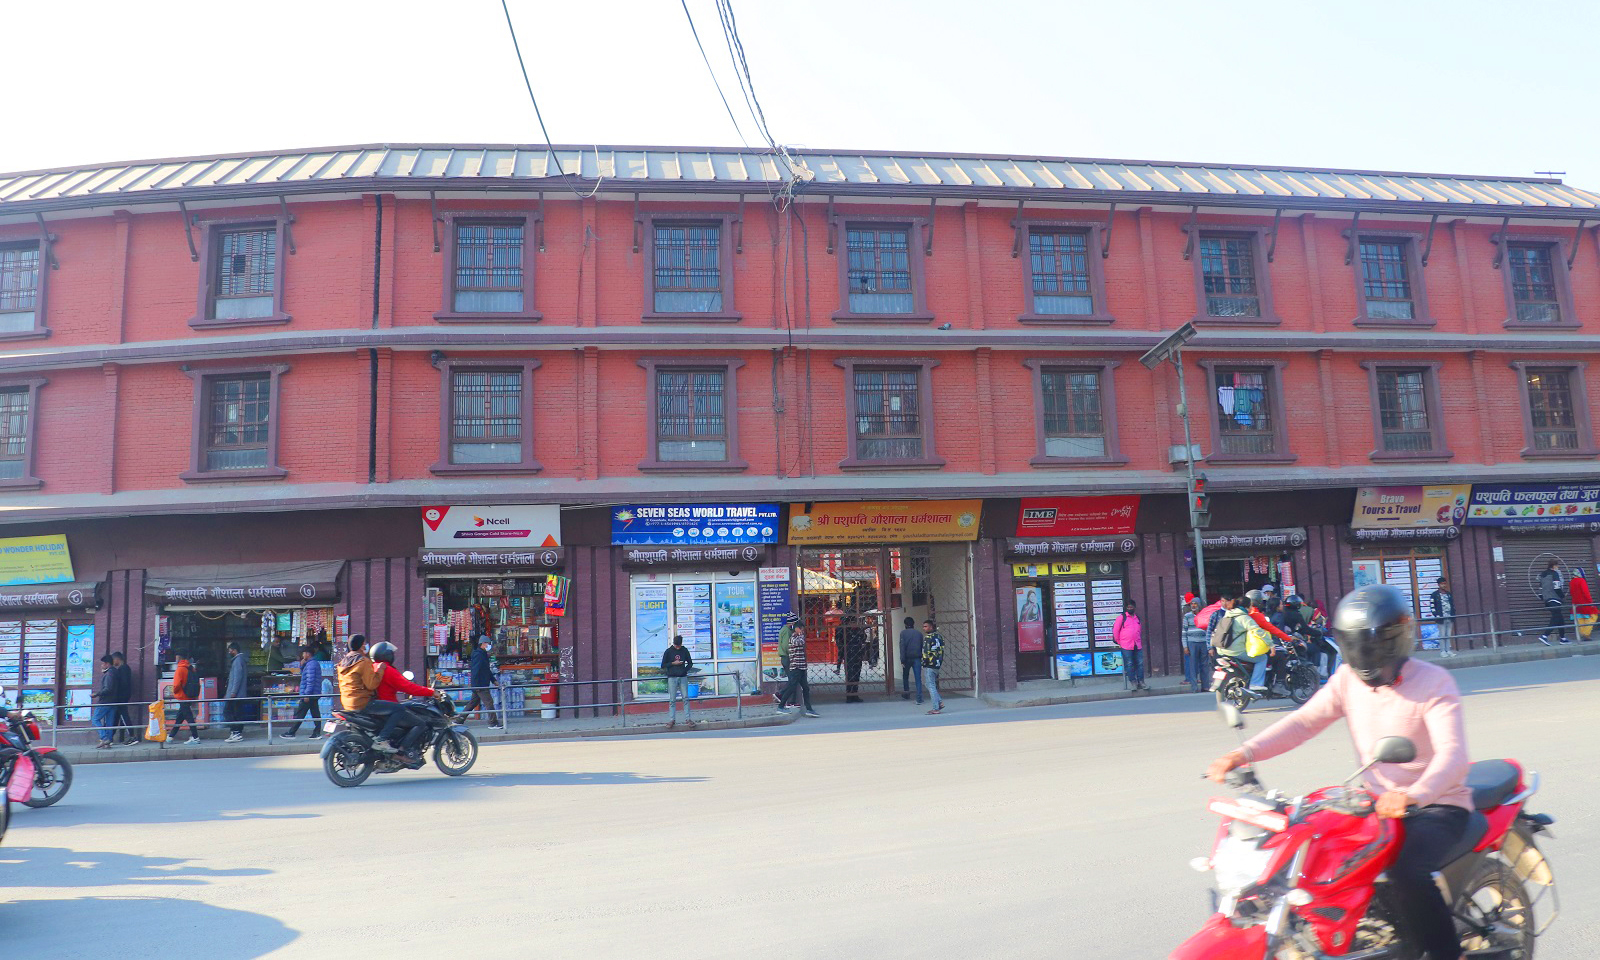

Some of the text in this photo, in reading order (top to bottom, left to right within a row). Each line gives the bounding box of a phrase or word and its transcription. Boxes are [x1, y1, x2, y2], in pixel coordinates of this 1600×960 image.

[1380, 494, 1405, 504] Bravo
[1476, 490, 1512, 504] पशुपति
[1514, 491, 1558, 502] फलफूल
[1560, 490, 1580, 500] तथा
[637, 508, 666, 518] SEVEN
[668, 508, 690, 518] SEAS
[692, 507, 724, 518] WORLD
[726, 507, 758, 518] TRAVEL
[1028, 510, 1054, 518] IME
[1362, 504, 1421, 514] Tours & Travel
[817, 512, 952, 528] श्री पशुपति गौशाला धर्मशाला
[4, 546, 34, 554] WONDER
[422, 552, 466, 567] श्रीपशुपति
[468, 552, 498, 565] गौशाला
[500, 552, 536, 565] धर्मशाला
[628, 550, 668, 564] श्रीपशुपति
[671, 549, 702, 562] गौशाला
[704, 548, 738, 560] धर्मशाला
[166, 587, 207, 602] श्रीपशुपति
[210, 587, 244, 600] गौशाला
[248, 586, 287, 599] धर्मशाला
[728, 586, 744, 595] TOUR
[24, 592, 59, 605] धर्मशाला
[640, 602, 665, 610] FLIGHT
